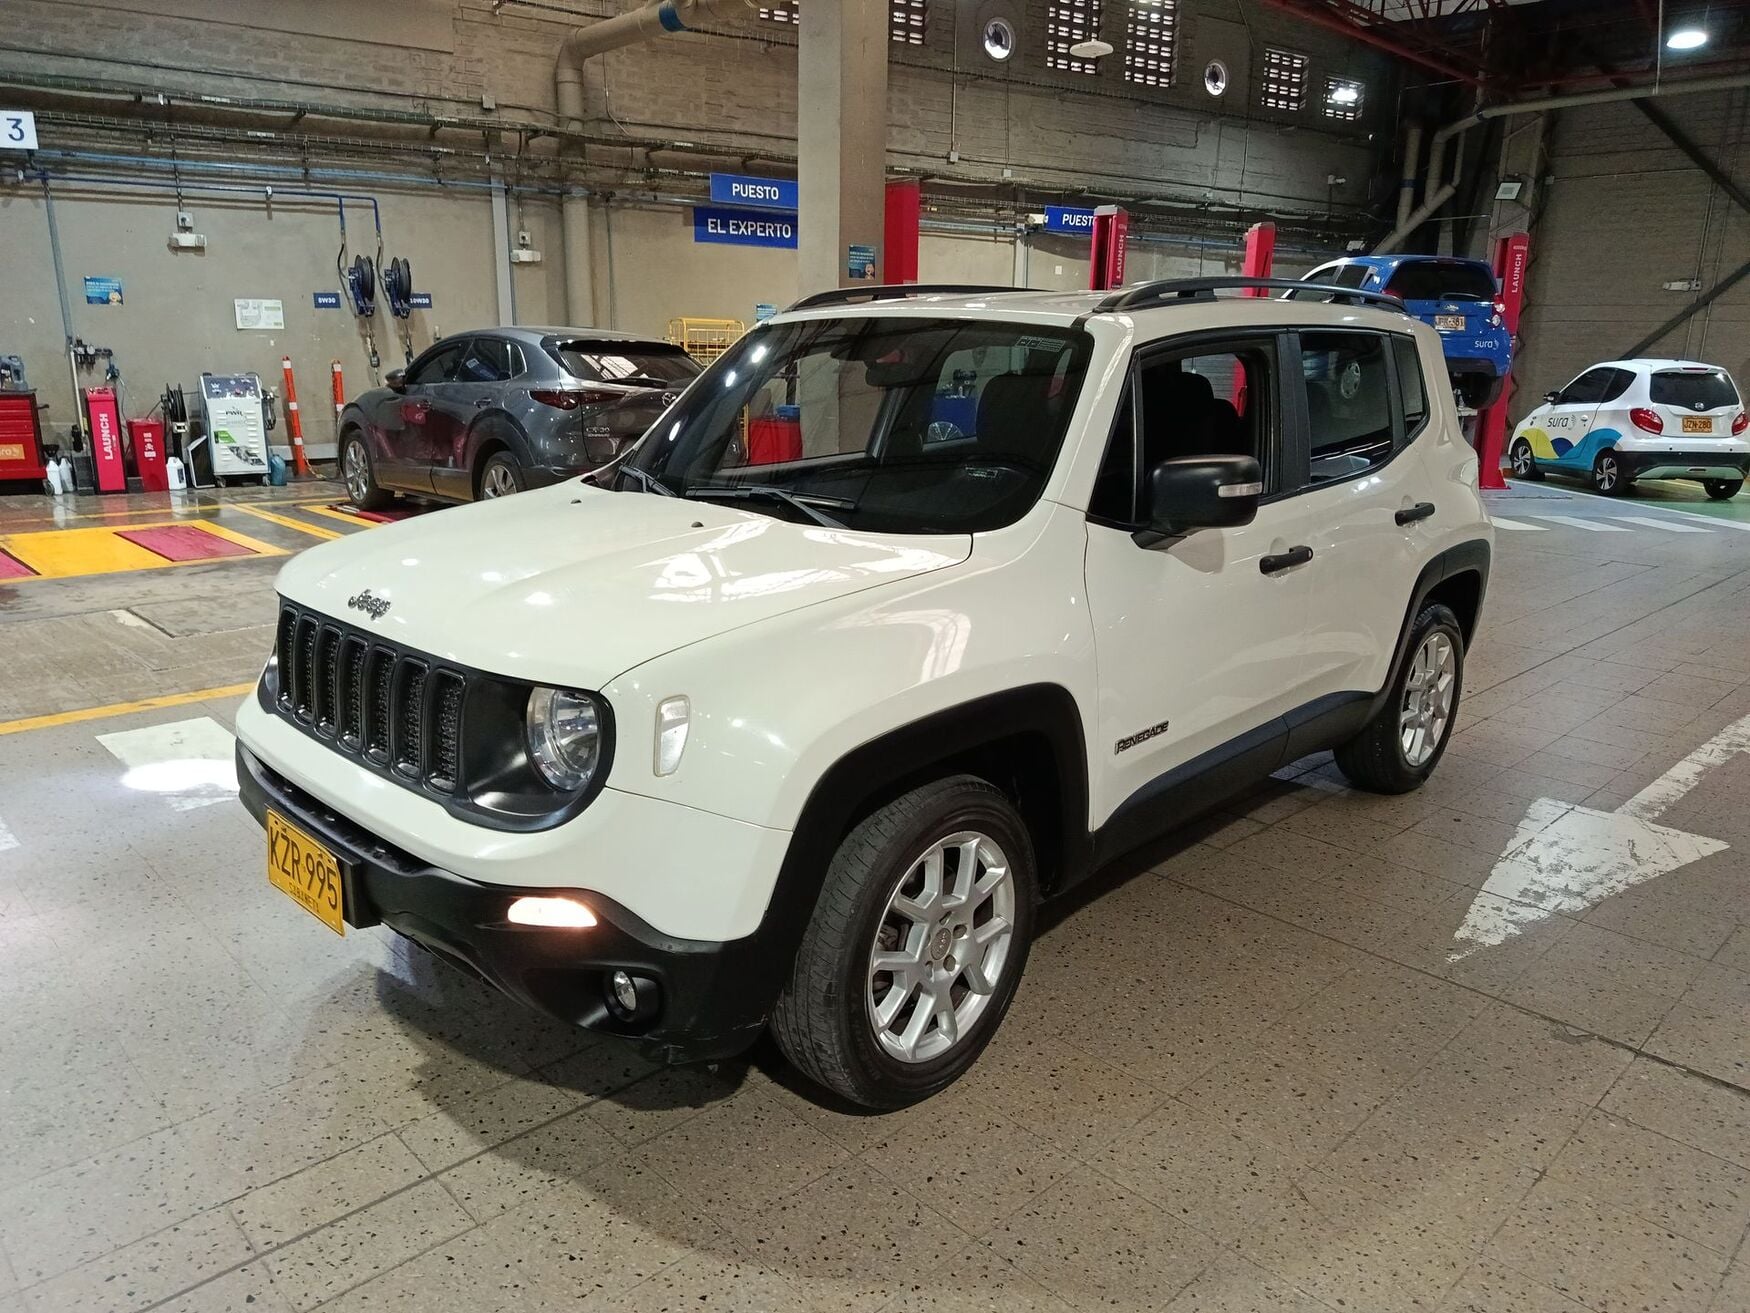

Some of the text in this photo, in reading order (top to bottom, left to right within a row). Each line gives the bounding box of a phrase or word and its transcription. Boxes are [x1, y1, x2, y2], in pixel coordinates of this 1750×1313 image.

[6, 117, 25, 142] 3
[732, 183, 779, 200] PUESTO
[707, 218, 792, 239] EL EXPERTO
[1116, 234, 1125, 279] LAUNCH
[1512, 254, 1522, 293] LAUNCH
[1474, 340, 1493, 348] sura
[1547, 417, 1569, 428] sura
[99, 413, 113, 460] LAUNCH
[1114, 720, 1169, 755] RENEGADE
